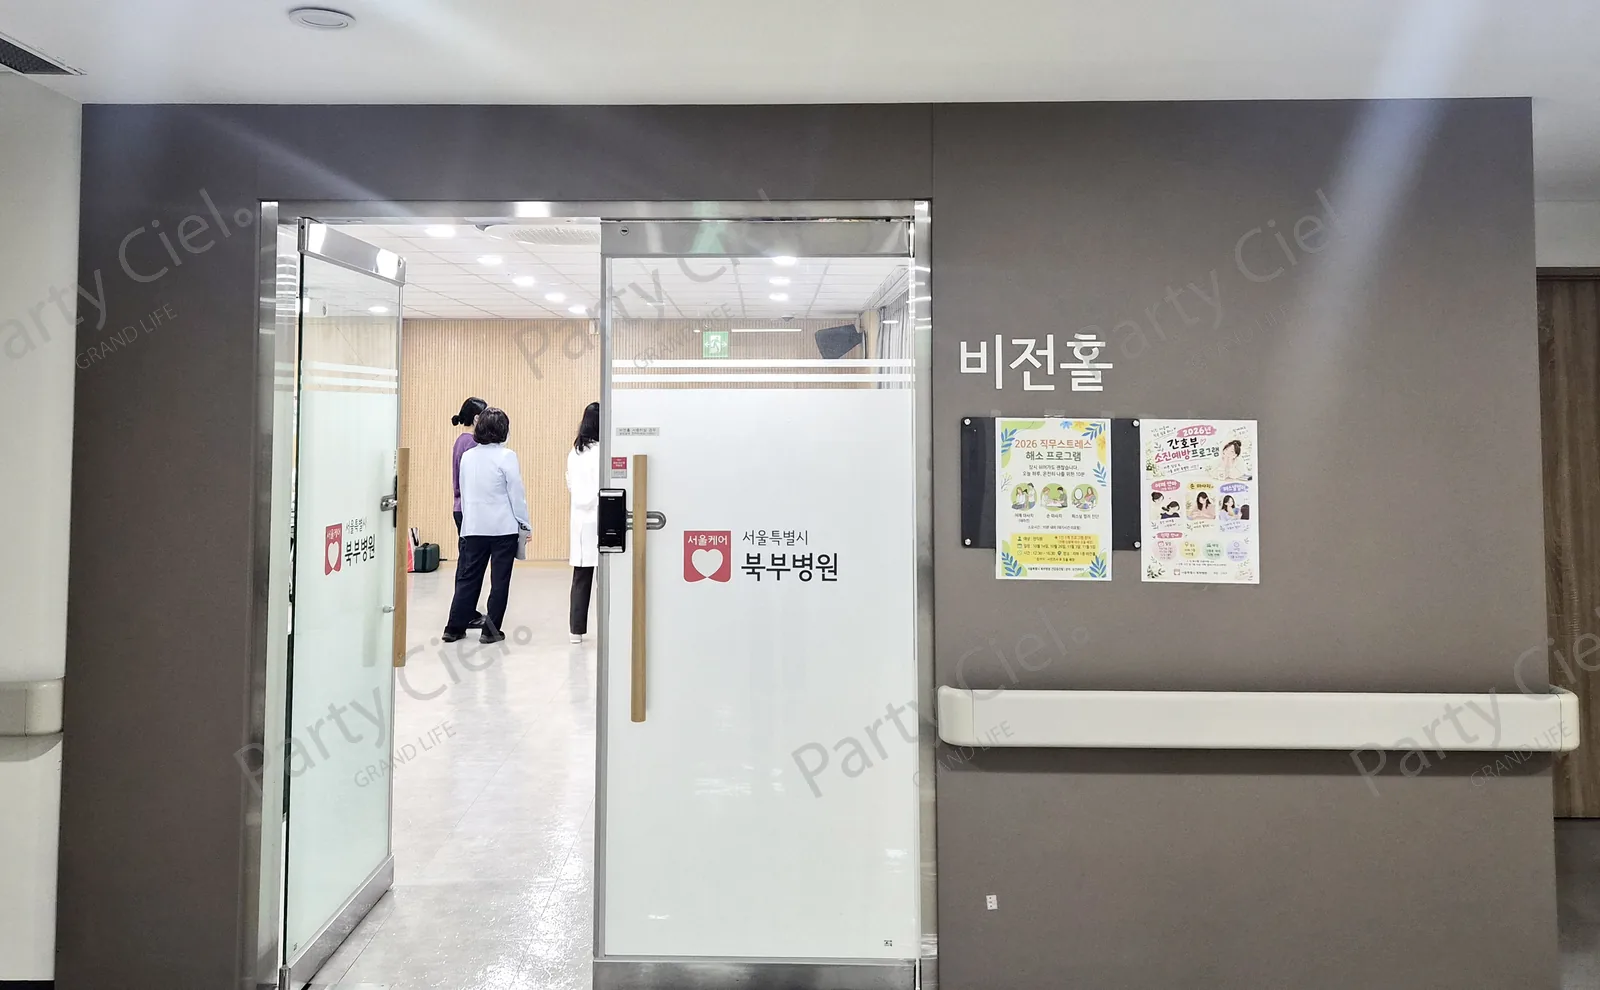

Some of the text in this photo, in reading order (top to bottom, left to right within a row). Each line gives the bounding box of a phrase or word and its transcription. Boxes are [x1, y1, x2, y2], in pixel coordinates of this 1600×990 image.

[960, 334, 1114, 392] 비전홀
[1182, 426, 1212, 436] 2026년
[1015, 439, 1092, 449] 2026 직무스트레스
[1167, 437, 1199, 450] 간호부
[1026, 451, 1082, 462] 해소 프로그램
[687, 534, 728, 546] 서울케어
[742, 529, 808, 546] 서울특별시
[344, 533, 376, 567] 북부병원
[741, 552, 838, 582] 북부병원
